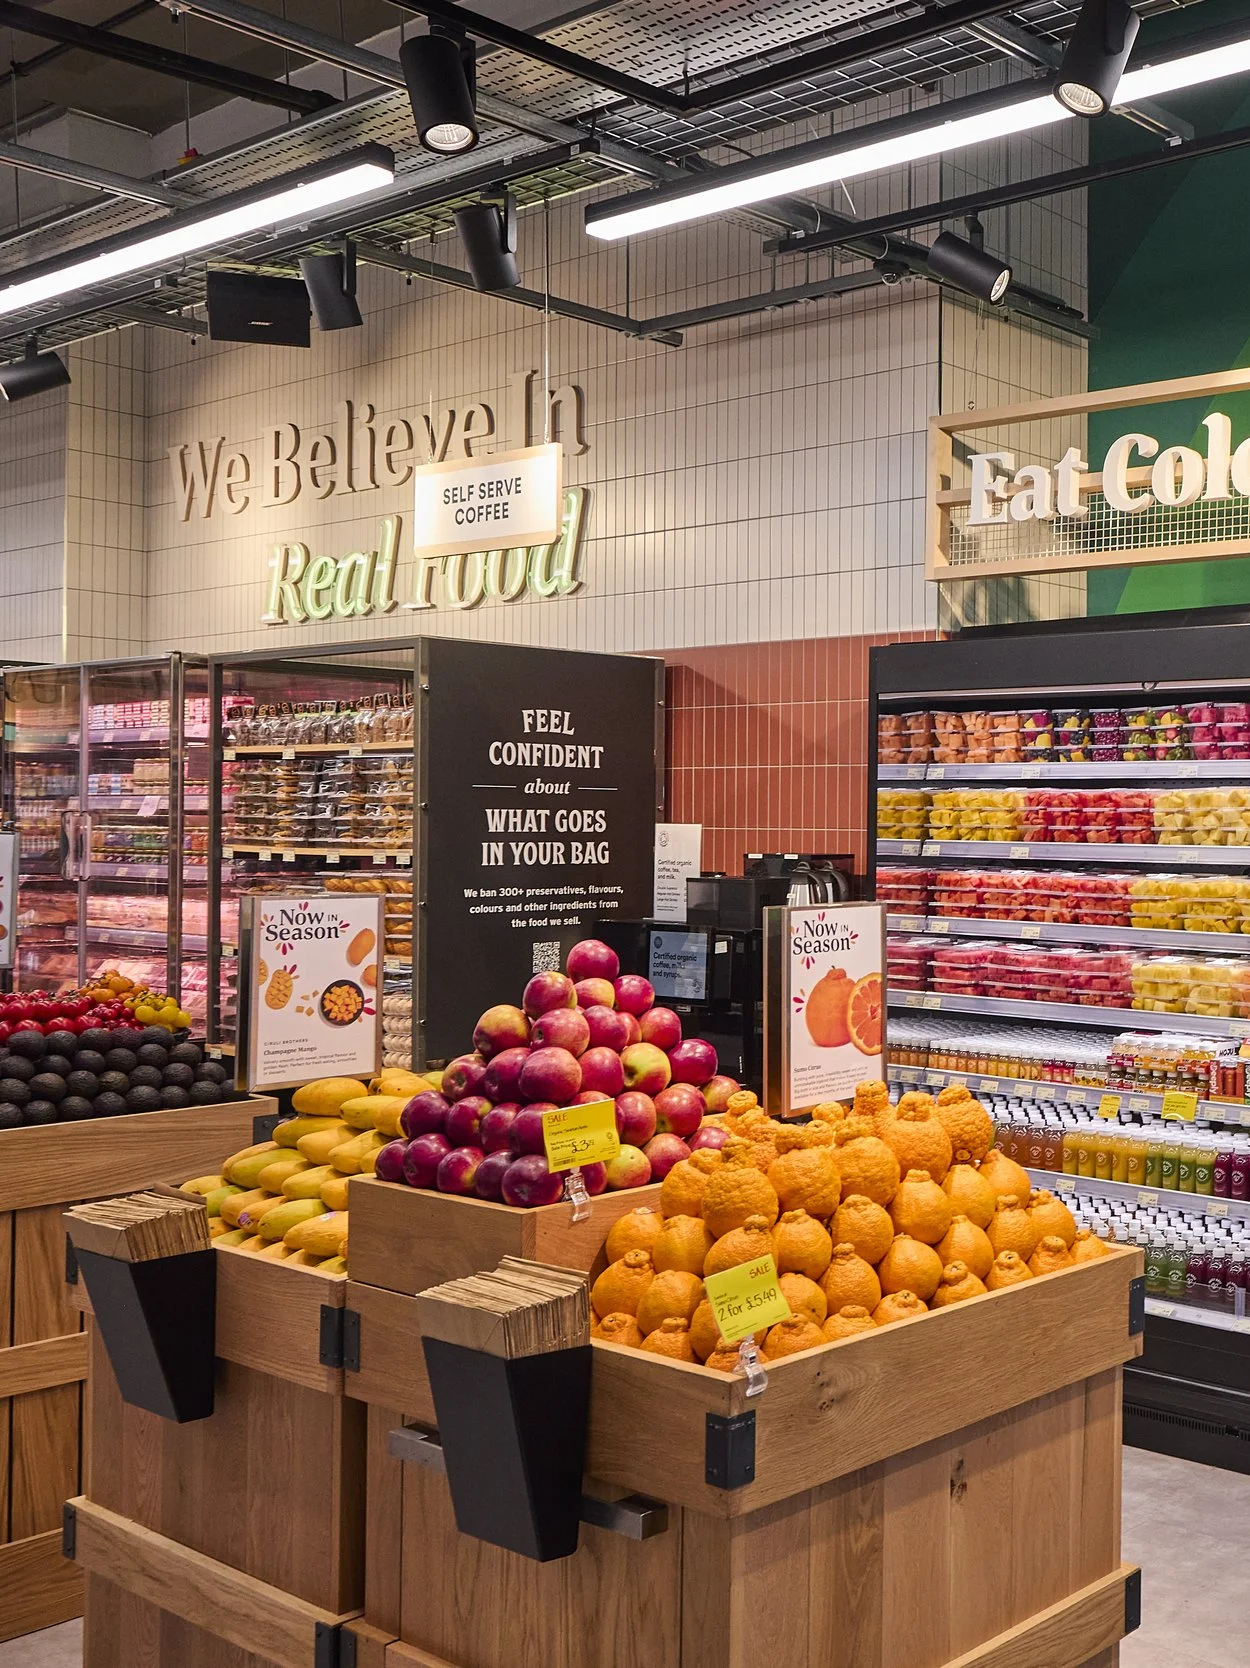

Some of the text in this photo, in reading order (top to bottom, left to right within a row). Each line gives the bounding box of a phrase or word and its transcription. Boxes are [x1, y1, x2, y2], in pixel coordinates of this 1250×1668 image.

[167, 370, 591, 521] We Believe In
[443, 477, 522, 505] SELF SERVE
[966, 447, 1088, 526] Eat
[454, 501, 510, 525] COFFEE
[262, 515, 401, 624] Real
[522, 709, 575, 735] FEEL
[489, 741, 604, 769] CONFIDENT
[524, 778, 571, 795] about
[485, 808, 607, 833] WHAT GOES
[481, 841, 610, 866] IN YOUR BAG
[464, 884, 624, 898] We ban 300+ preservatives, flavours,
[469, 899, 618, 914] colours and other ingredients from
[280, 909, 338, 926] Now IN
[511, 918, 526, 927] the
[528, 917, 547, 927] food
[563, 917, 581, 925] sell.
[265, 924, 340, 942] Season
[803, 920, 849, 938] Now IN
[792, 936, 850, 956] Season
[653, 952, 676, 961] Certified
[1219, 1047, 1234, 1057] MOJU
[547, 1112, 568, 1124] SALE
[749, 1262, 771, 1279] SALE
[717, 1307, 727, 1322] 2
[727, 1303, 742, 1317] for
[746, 1288, 777, 1310] £5.49
